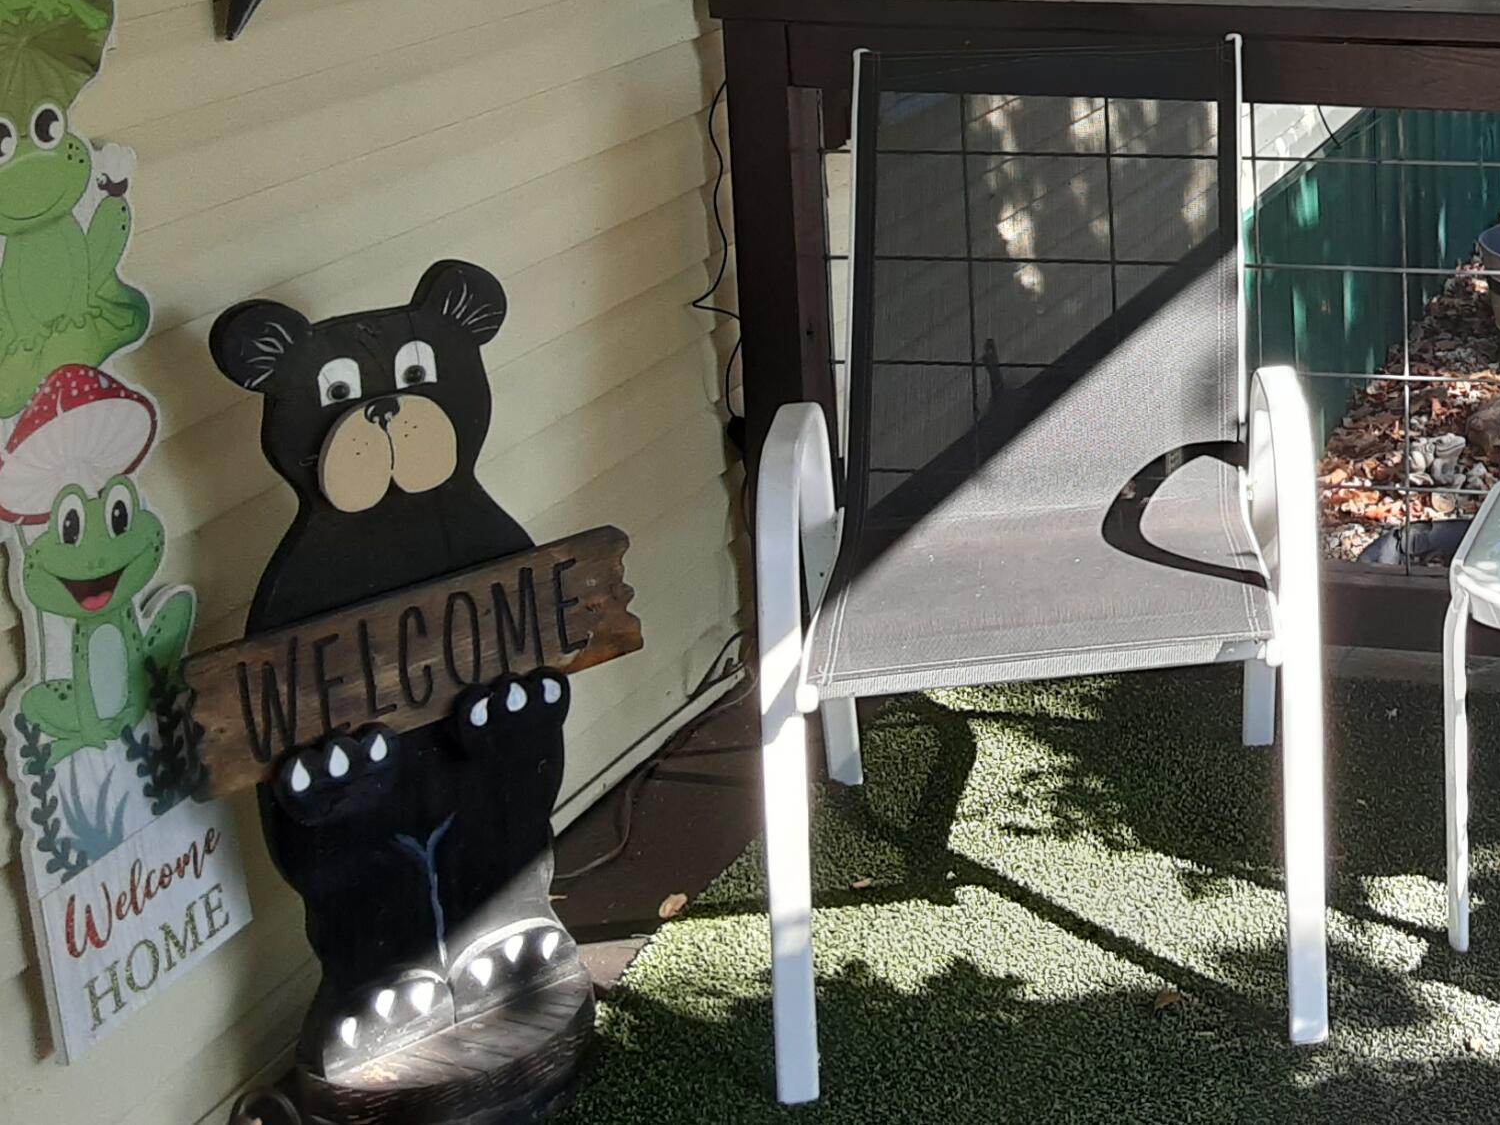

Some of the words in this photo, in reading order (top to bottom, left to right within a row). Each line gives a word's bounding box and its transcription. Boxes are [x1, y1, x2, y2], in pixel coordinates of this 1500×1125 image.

[238, 558, 590, 763] WELCOME
[65, 827, 221, 958] Welcome
[84, 883, 229, 1031] HOME
